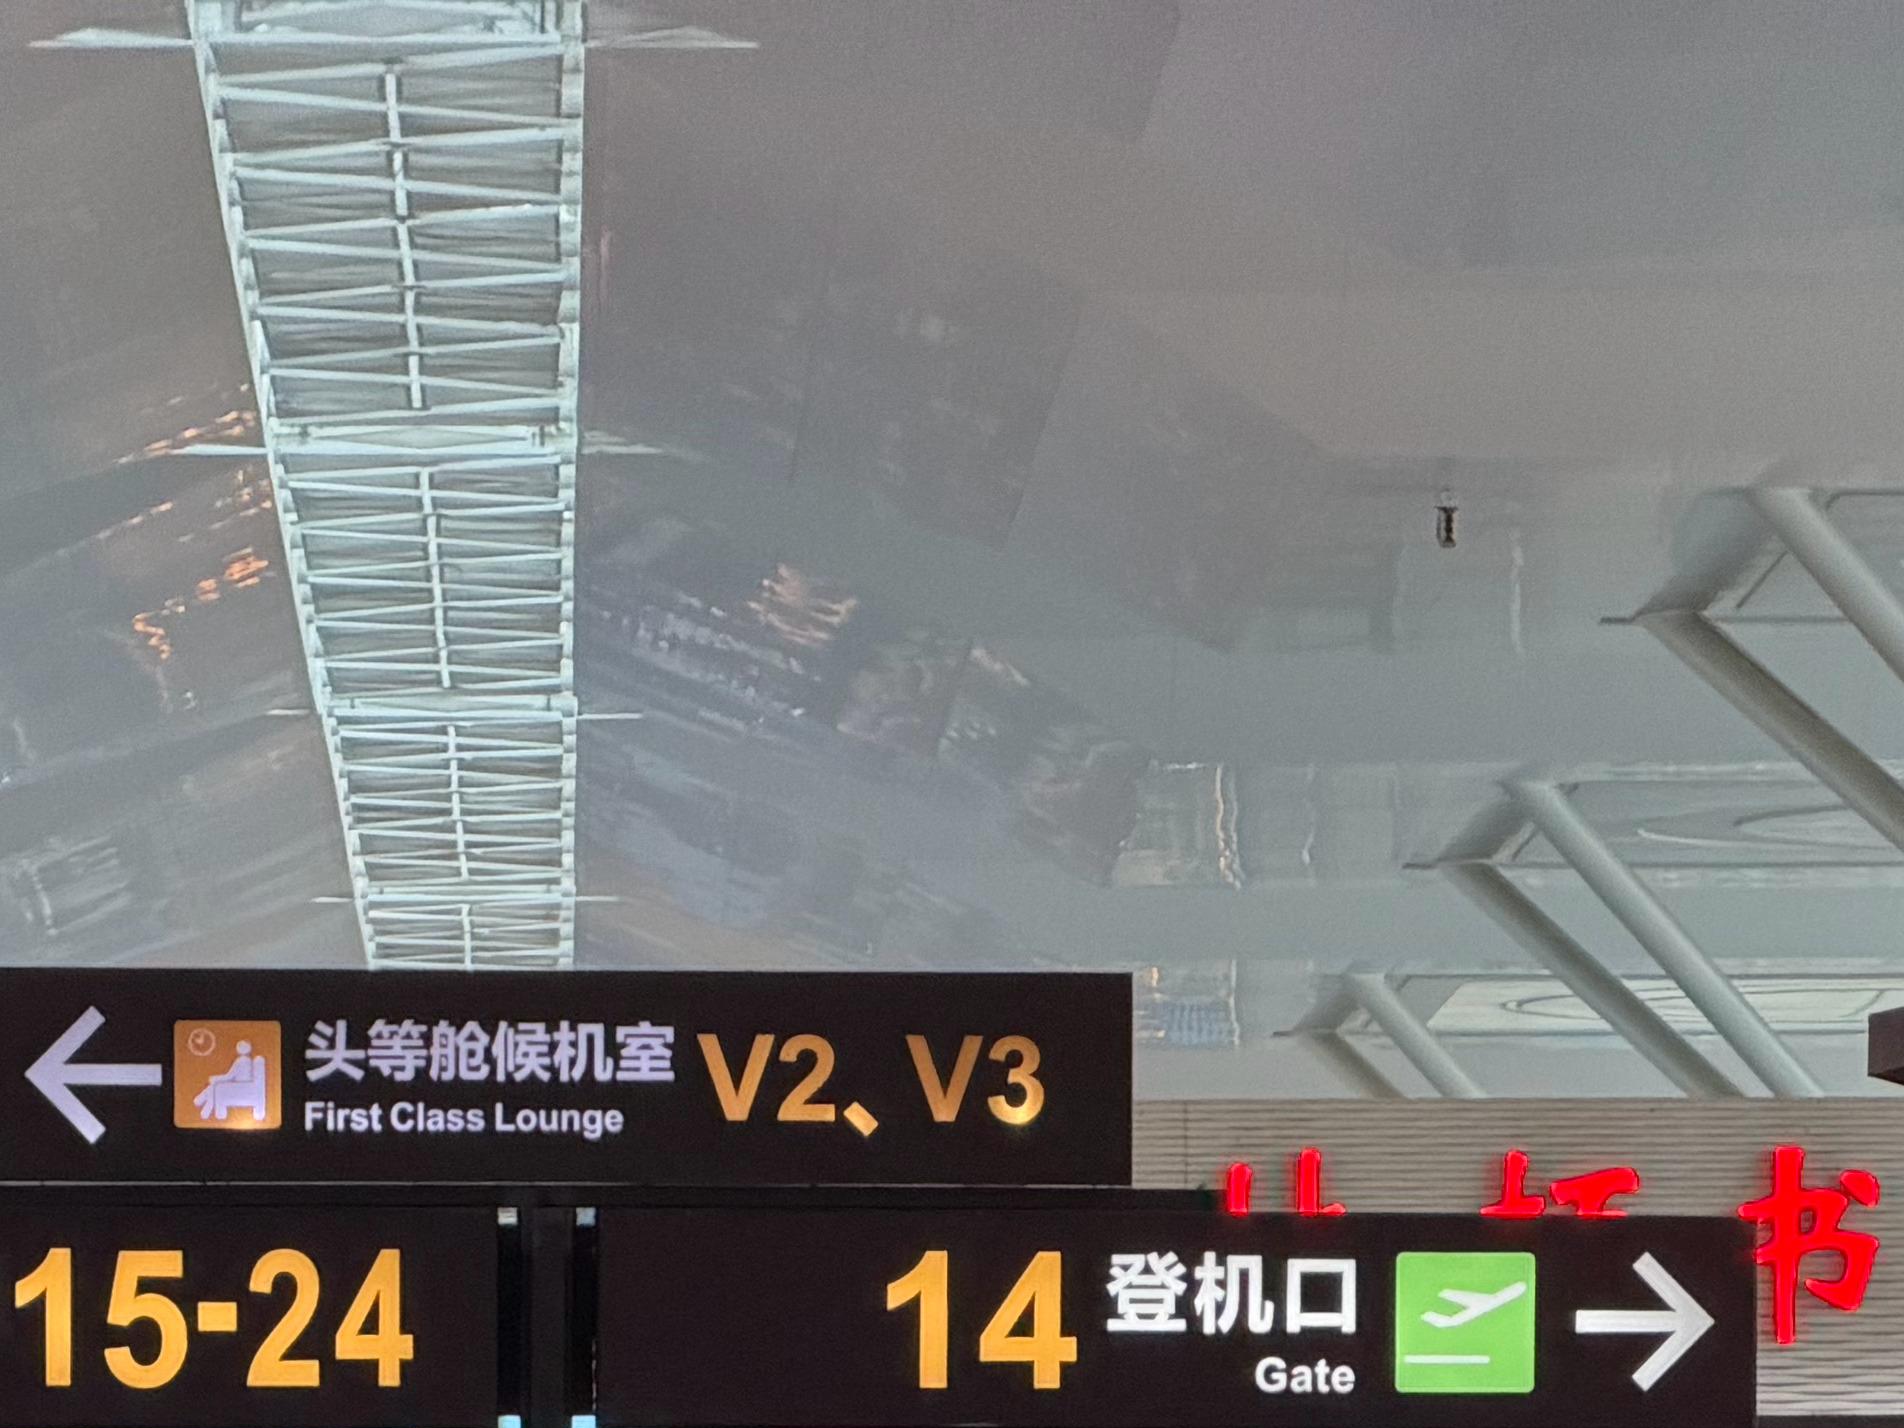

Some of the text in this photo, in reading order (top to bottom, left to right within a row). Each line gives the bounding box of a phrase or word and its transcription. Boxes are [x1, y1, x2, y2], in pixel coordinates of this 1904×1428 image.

[304, 1021, 676, 1083] 头等舱候机室
[304, 1102, 624, 1138] First Class Lounge
[14, 1248, 414, 1388] 15-24
[886, 1250, 1078, 1389] 14
[1105, 1252, 1358, 1336] 登机口
[1255, 1357, 1356, 1394] Gate
